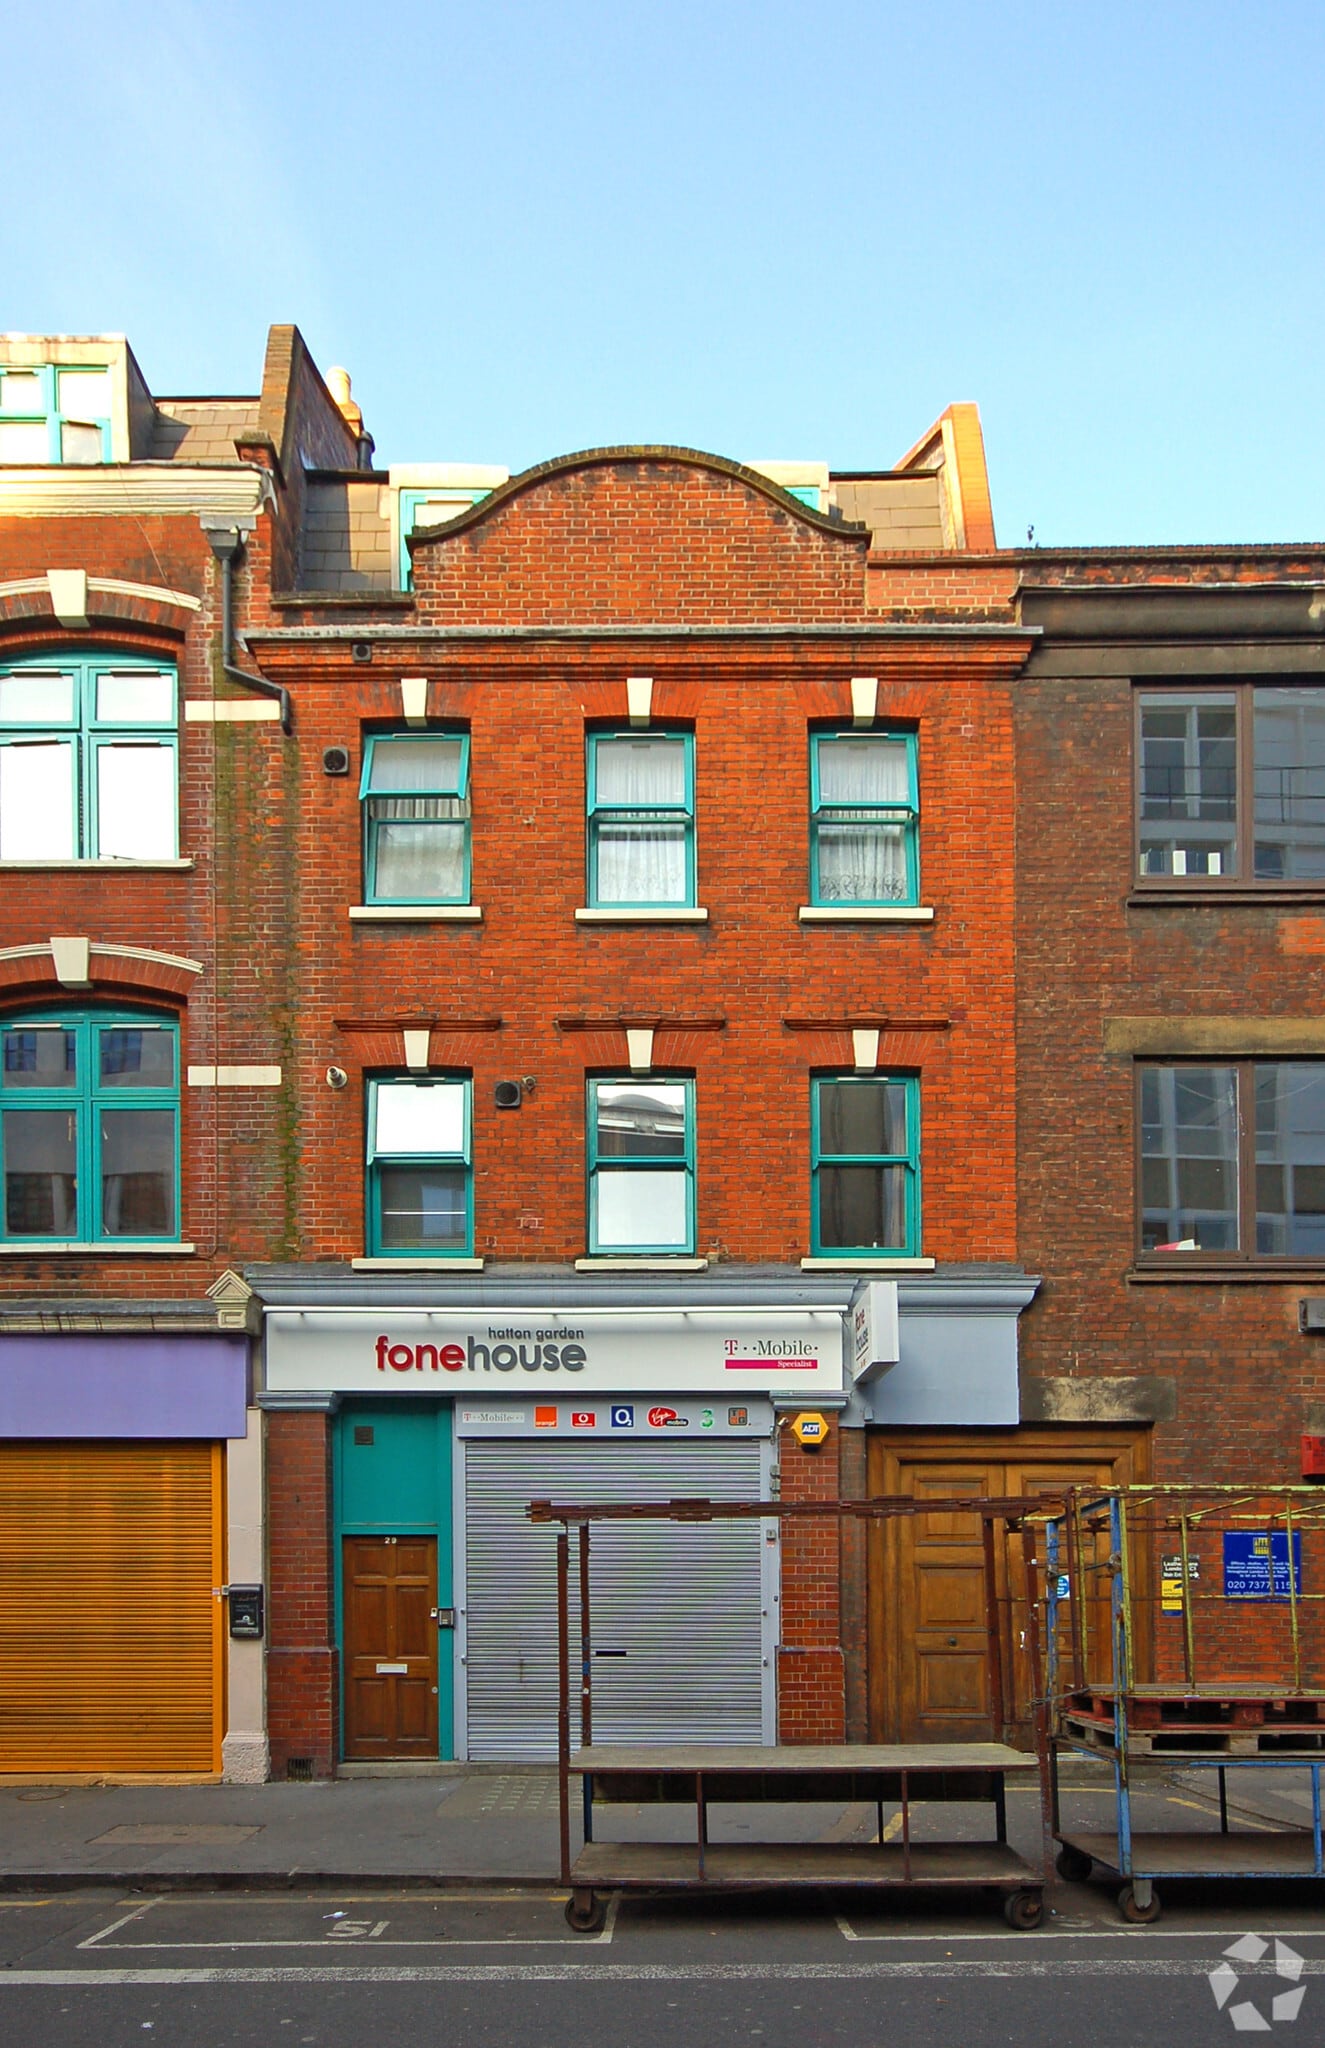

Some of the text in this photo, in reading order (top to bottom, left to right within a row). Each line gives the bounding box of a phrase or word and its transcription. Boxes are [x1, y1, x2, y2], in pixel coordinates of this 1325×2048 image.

[488, 1327, 585, 1342] hatton garden
[375, 1335, 588, 1372] fonehouse
[802, 1424, 819, 1433] ADT
[1227, 1581, 1246, 1589] 020
[1248, 1581, 1271, 1589] 7377
[325, 1920, 390, 1937] 51
